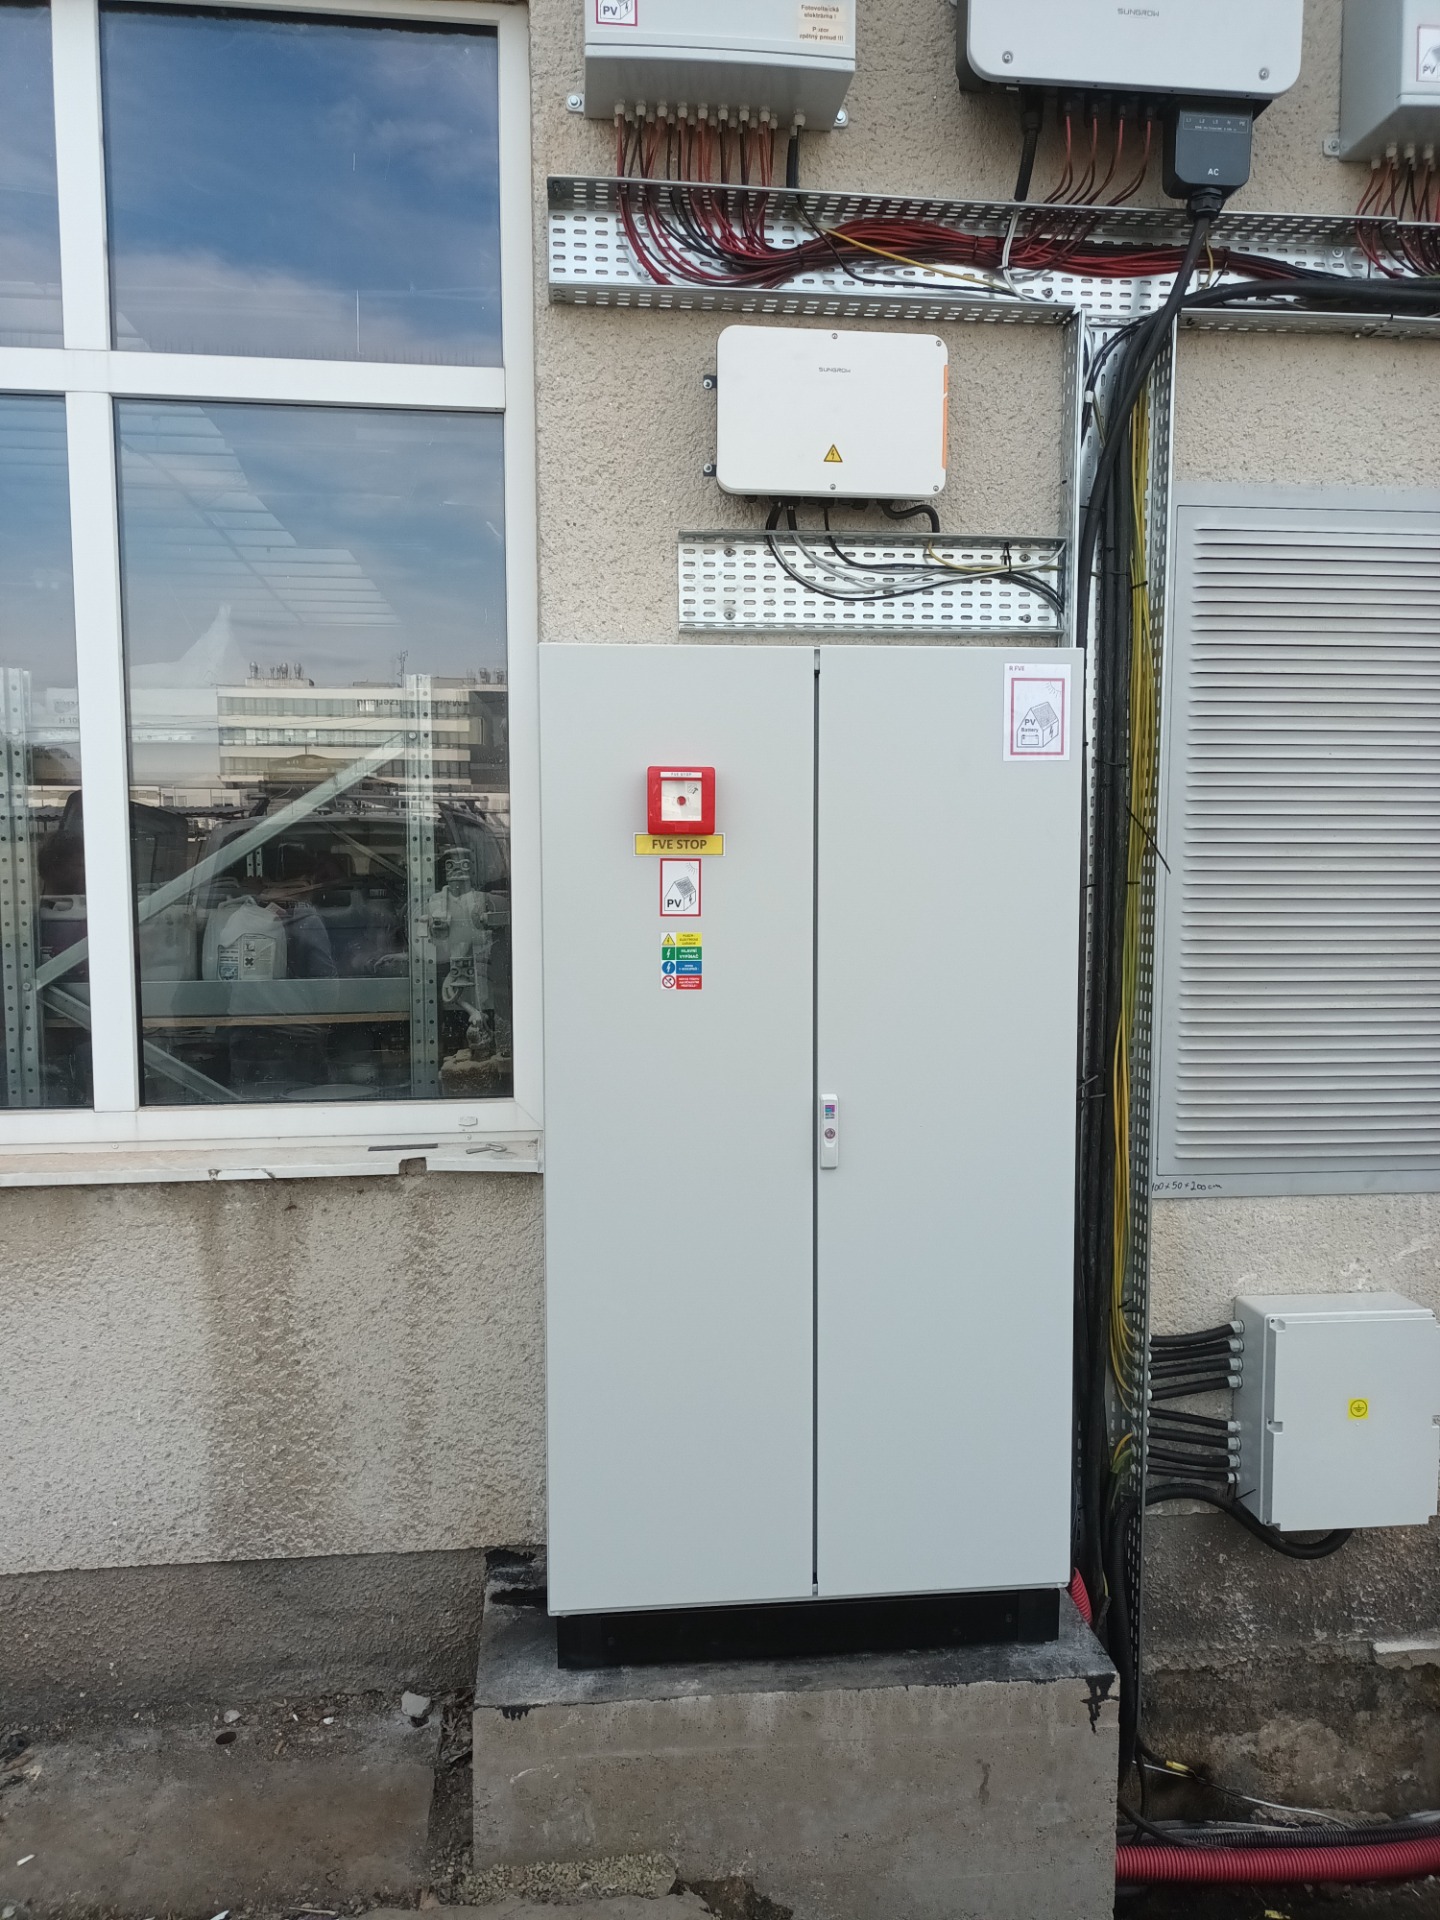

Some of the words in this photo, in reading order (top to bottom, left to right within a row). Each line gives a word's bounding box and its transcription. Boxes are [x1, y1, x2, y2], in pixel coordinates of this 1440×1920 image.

[603, 6, 618, 16] PV
[1117, 8, 1160, 17] SUNGROW
[1423, 65, 1437, 75] PV
[1207, 168, 1220, 176] AC
[818, 366, 851, 374] SUNGROW
[652, 839, 674, 850] FVE
[676, 839, 707, 850] STOP
[667, 899, 682, 908] PV
